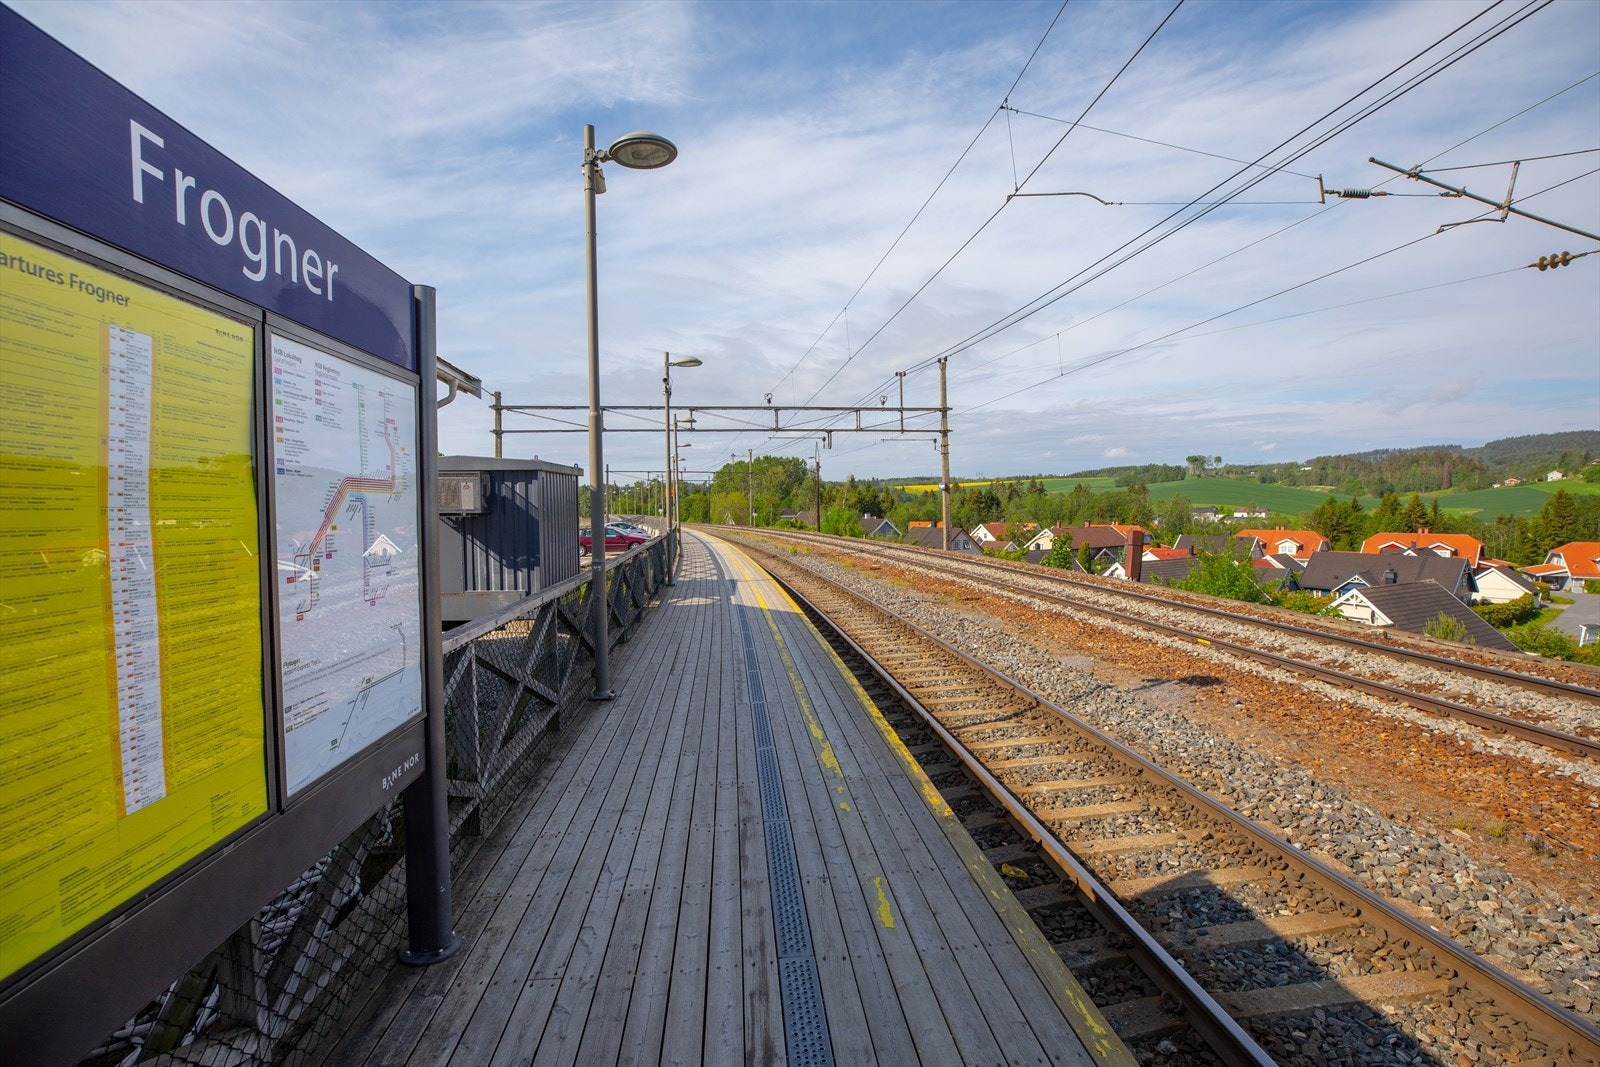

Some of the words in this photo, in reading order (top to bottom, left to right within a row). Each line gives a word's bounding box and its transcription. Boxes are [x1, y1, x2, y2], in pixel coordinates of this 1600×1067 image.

[130, 118, 339, 302] Frogner
[69, 272, 131, 307] Frogner
[382, 766, 402, 790] BANE
[404, 753, 419, 772] NOR
